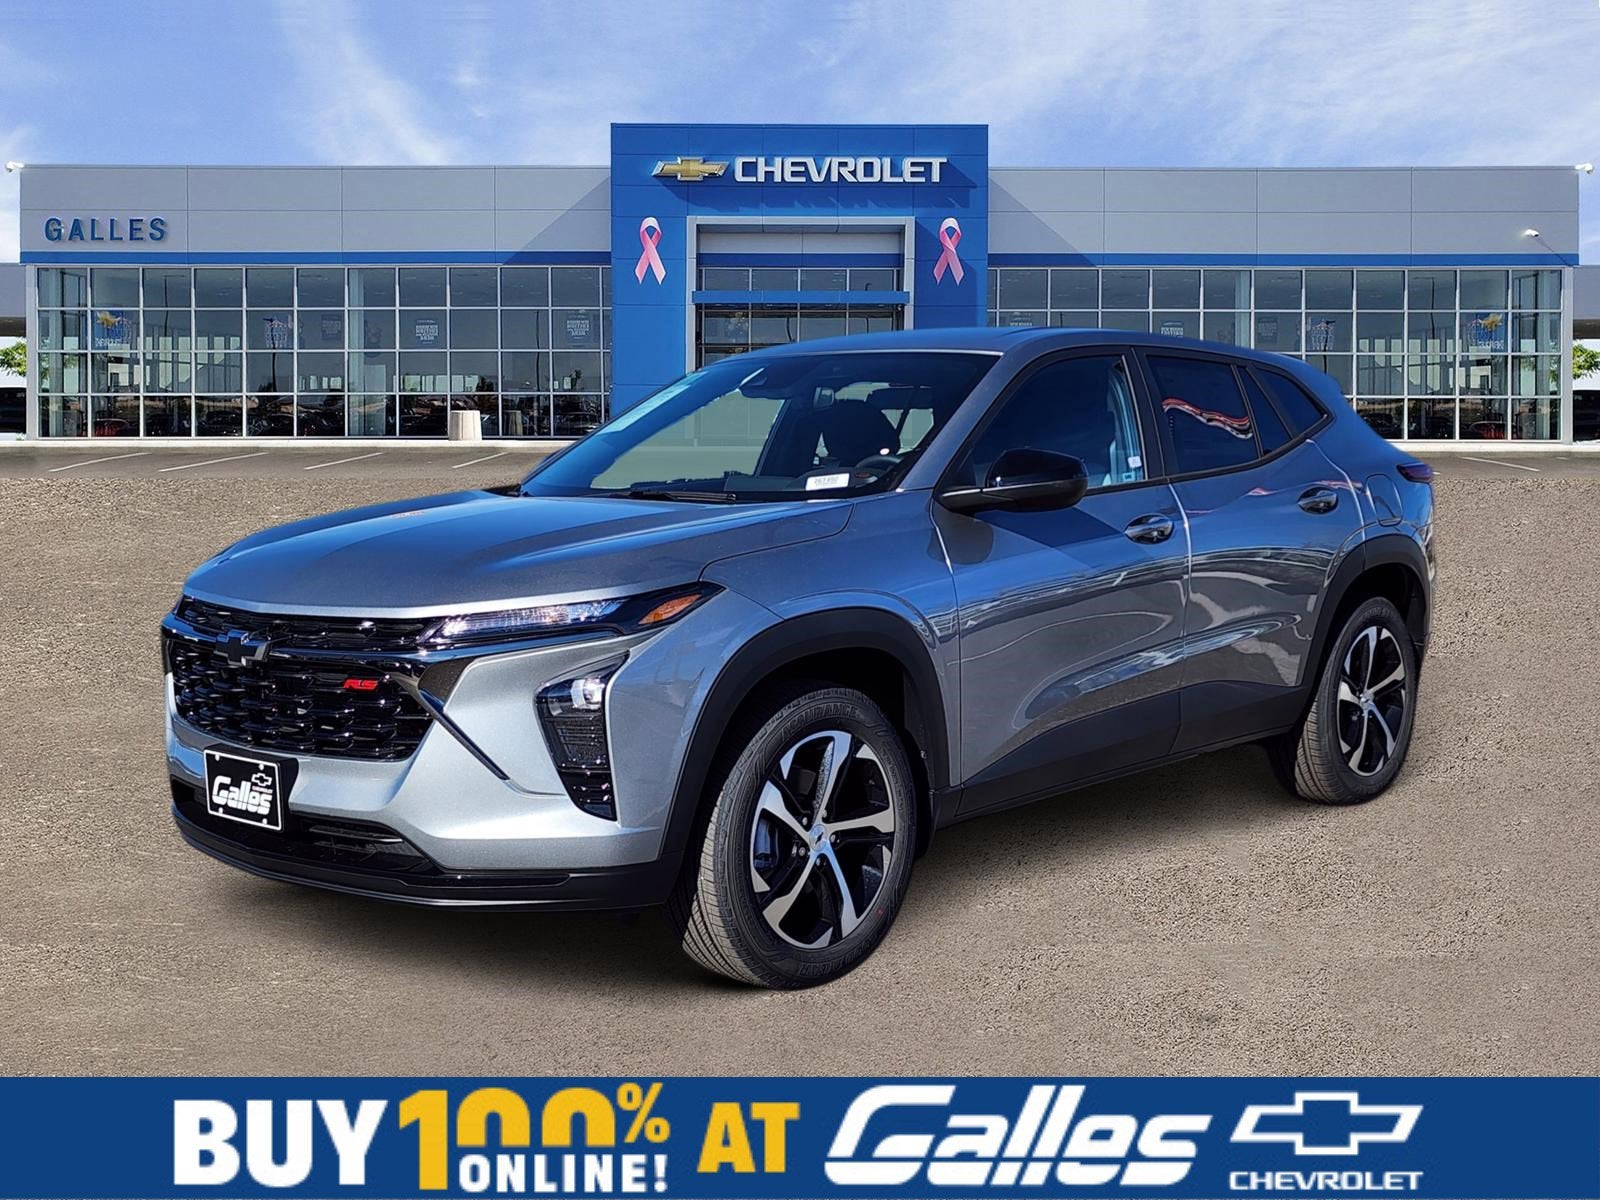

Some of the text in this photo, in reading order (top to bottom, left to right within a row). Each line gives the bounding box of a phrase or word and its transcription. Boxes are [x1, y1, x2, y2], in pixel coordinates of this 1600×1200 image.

[734, 156, 948, 183] CHEVROLET
[44, 217, 168, 241] GALLES
[343, 678, 378, 690] RS
[212, 775, 273, 816] Galles
